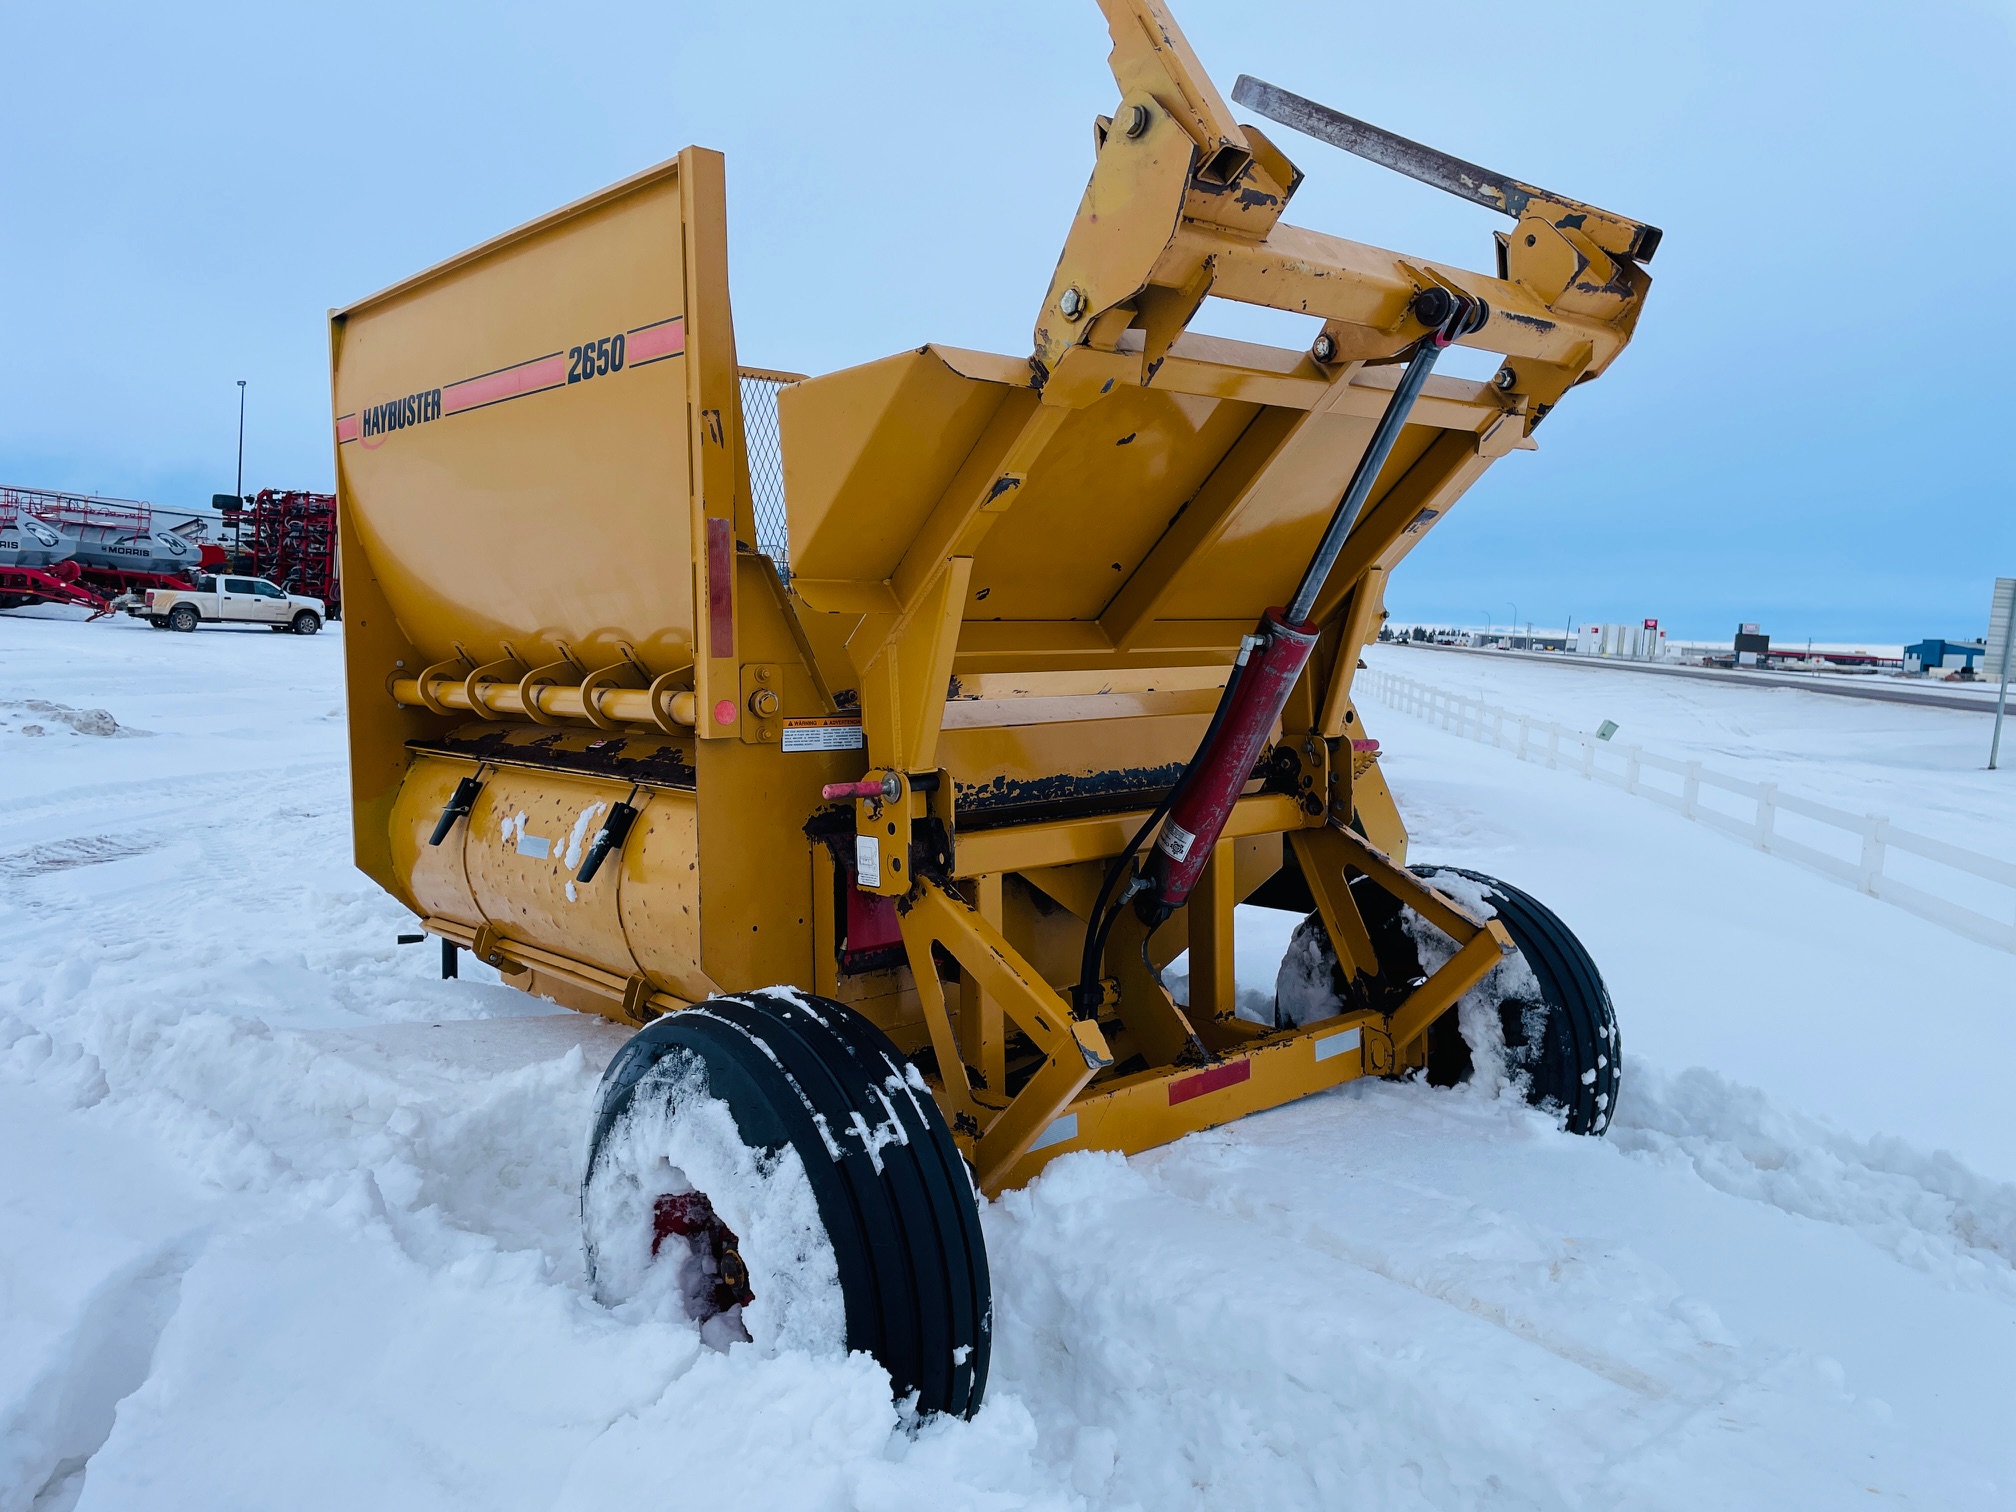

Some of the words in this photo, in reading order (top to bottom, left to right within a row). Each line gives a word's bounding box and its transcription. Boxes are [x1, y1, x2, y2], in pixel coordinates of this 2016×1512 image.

[567, 333, 626, 385] 2650
[363, 388, 441, 437] HAYBUSTER
[108, 546, 150, 557] MORRIS
